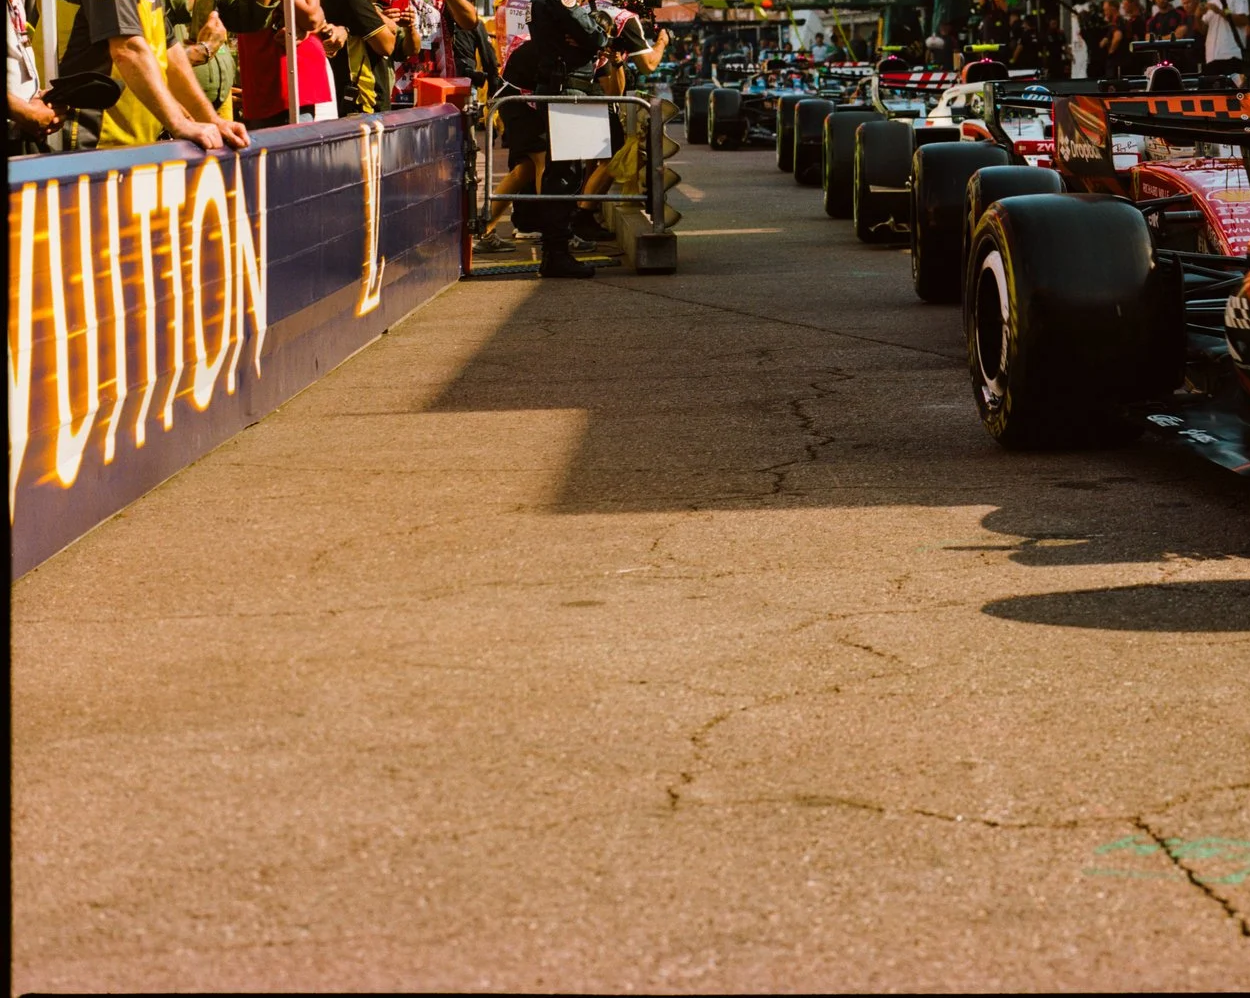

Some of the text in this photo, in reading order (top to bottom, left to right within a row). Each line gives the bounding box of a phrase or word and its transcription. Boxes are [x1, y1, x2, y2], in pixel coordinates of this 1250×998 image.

[1070, 140, 1103, 162] Dropbox
[1142, 183, 1170, 197] RICHARD MILLE
